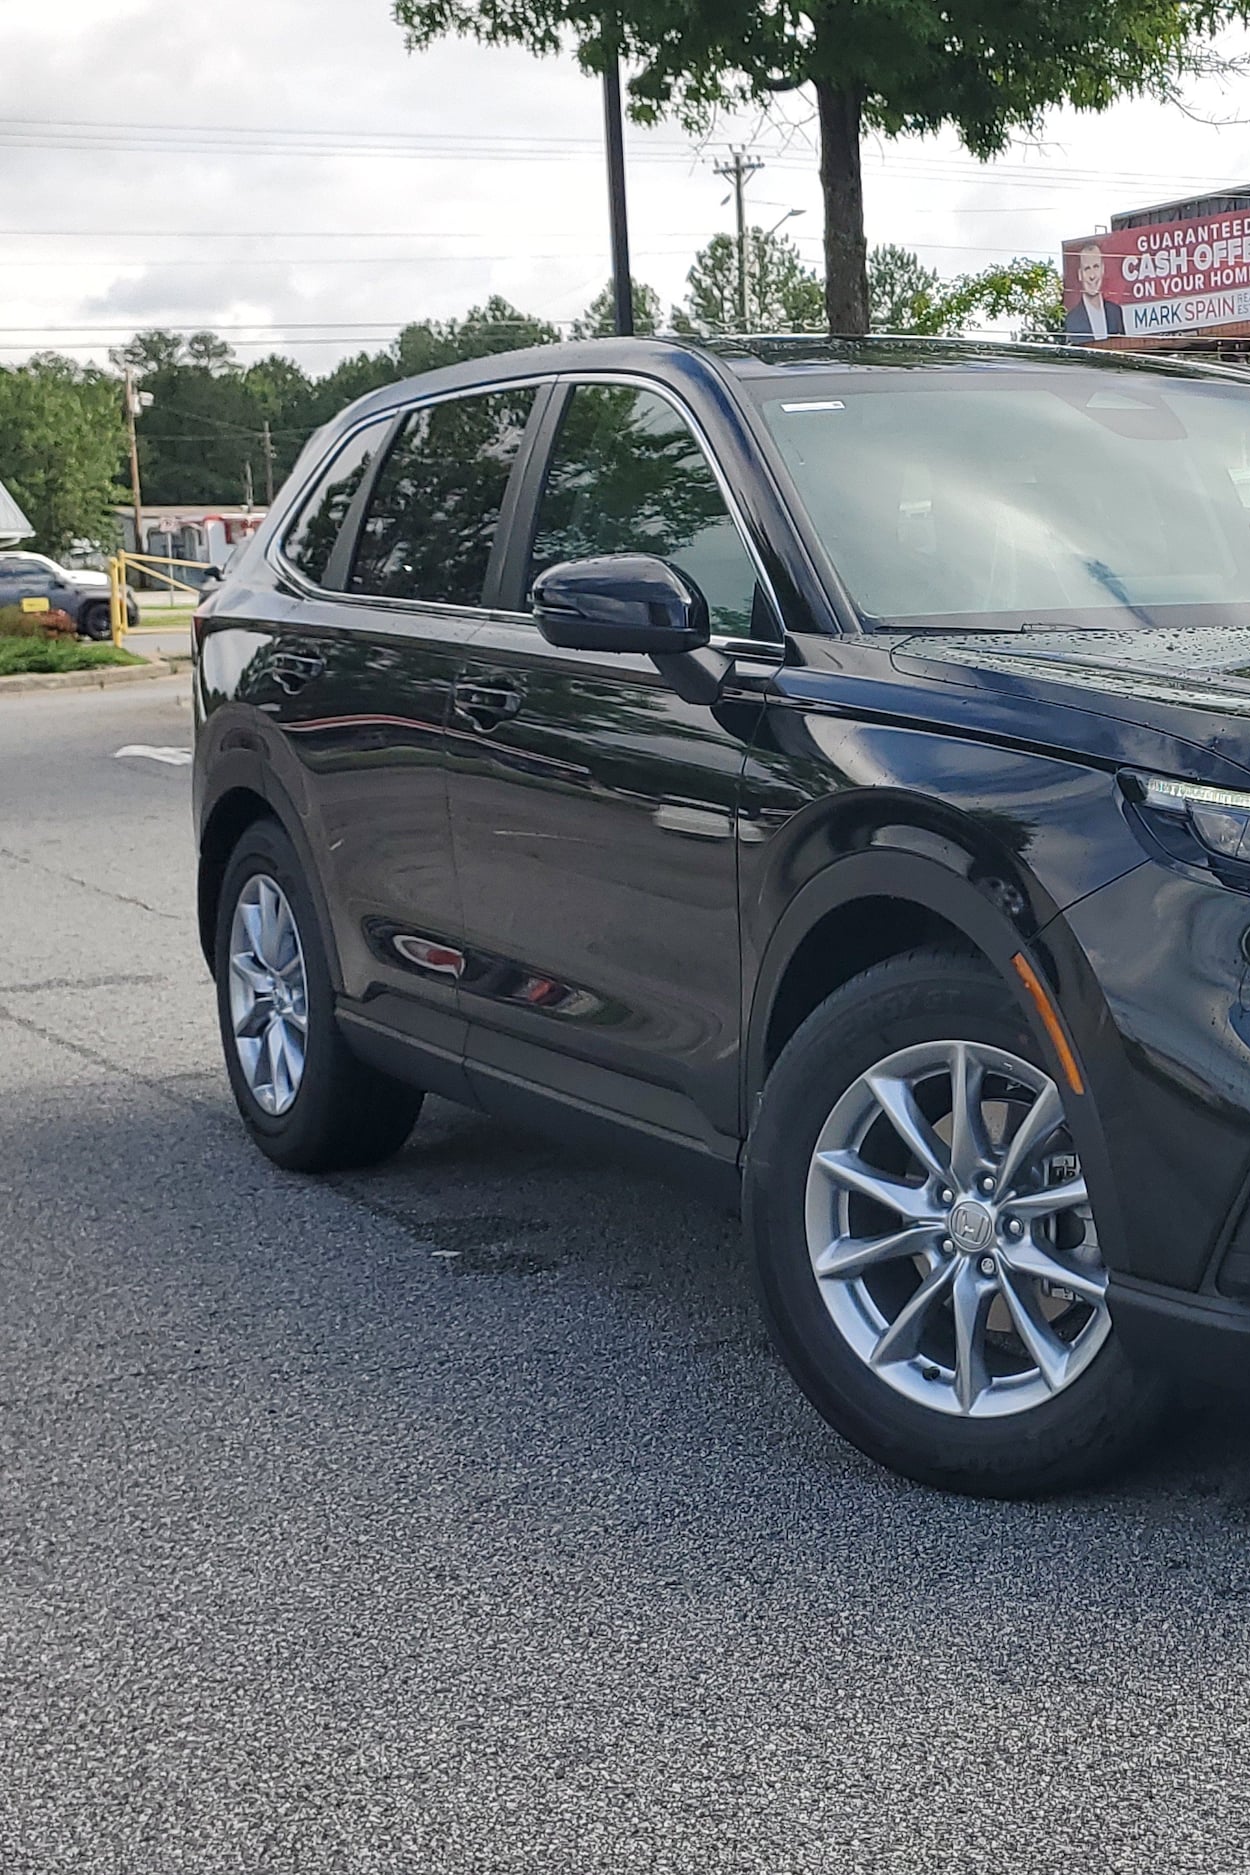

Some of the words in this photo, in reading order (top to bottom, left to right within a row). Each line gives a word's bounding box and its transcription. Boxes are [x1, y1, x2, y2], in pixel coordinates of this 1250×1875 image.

[1122, 246, 1188, 281] CASH
[1133, 282, 1155, 298] ON
[1161, 274, 1204, 294] YOUR
[1134, 303, 1183, 328] MARK
[1184, 295, 1235, 321] SPAIN
